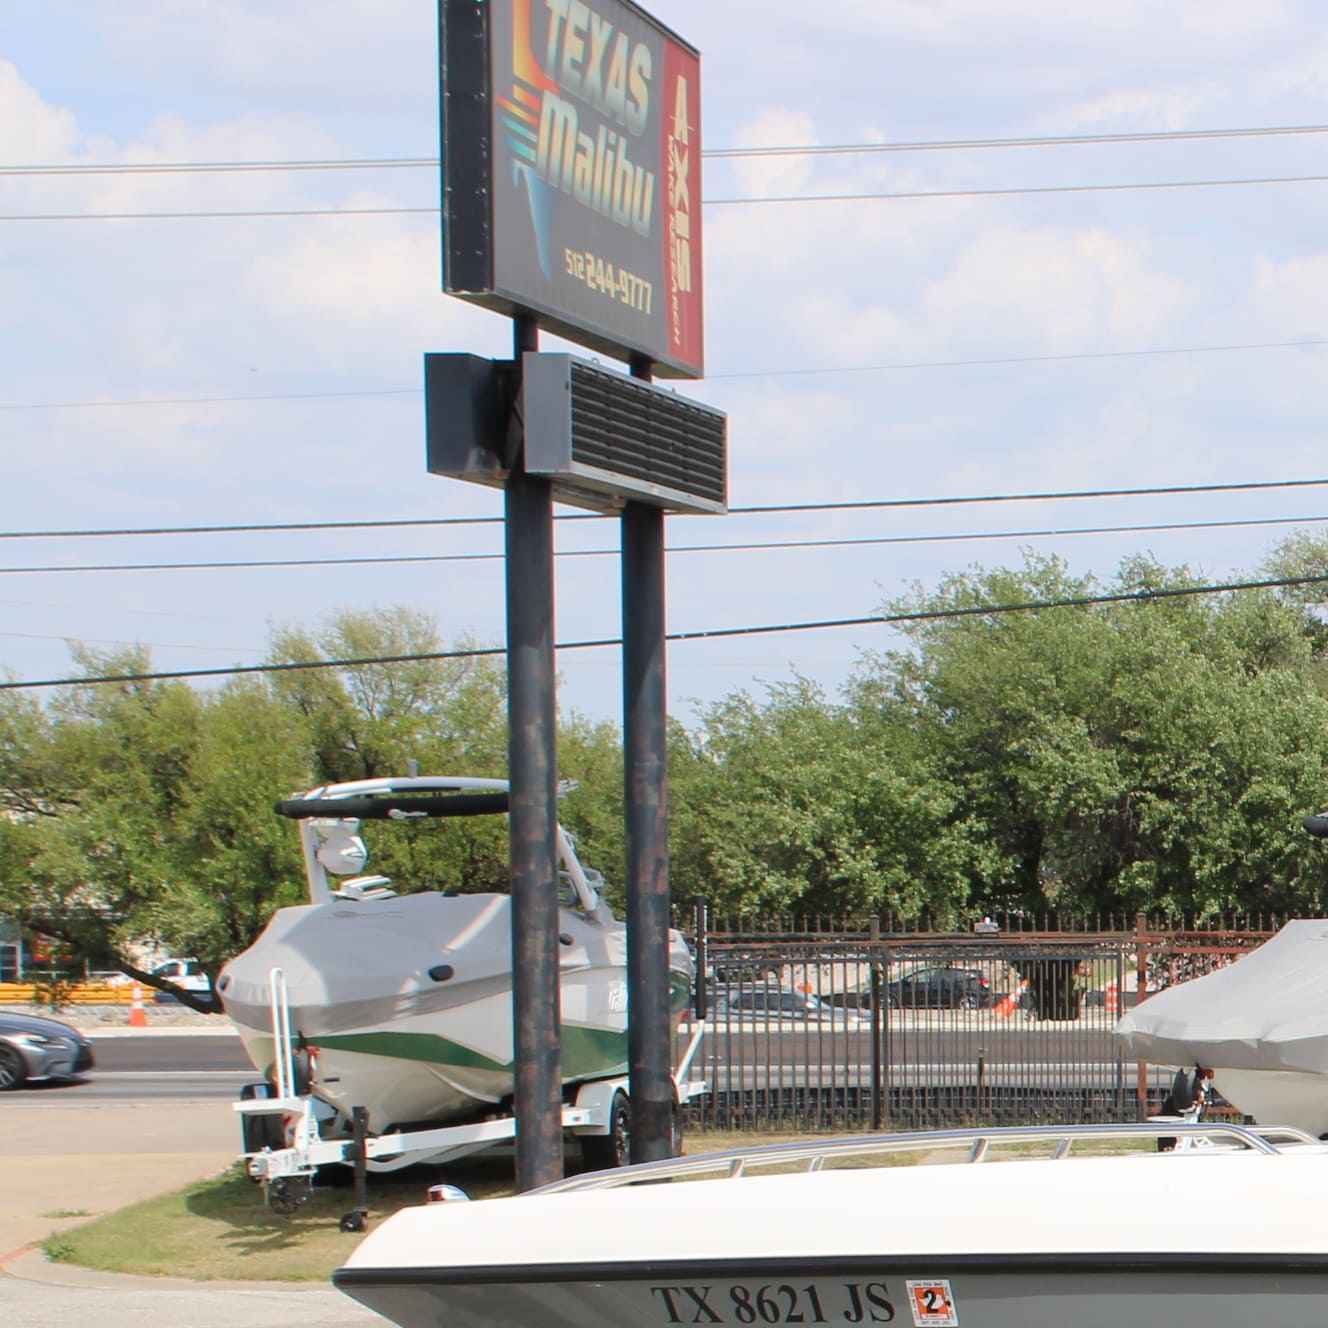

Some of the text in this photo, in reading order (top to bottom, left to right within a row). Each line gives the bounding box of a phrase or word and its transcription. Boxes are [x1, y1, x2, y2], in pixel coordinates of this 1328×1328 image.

[545, 0, 652, 136] TEXAS
[536, 89, 656, 238] Malibu
[673, 75, 692, 293] AXIS
[650, 1283, 895, 1324] TX 8621 JS
